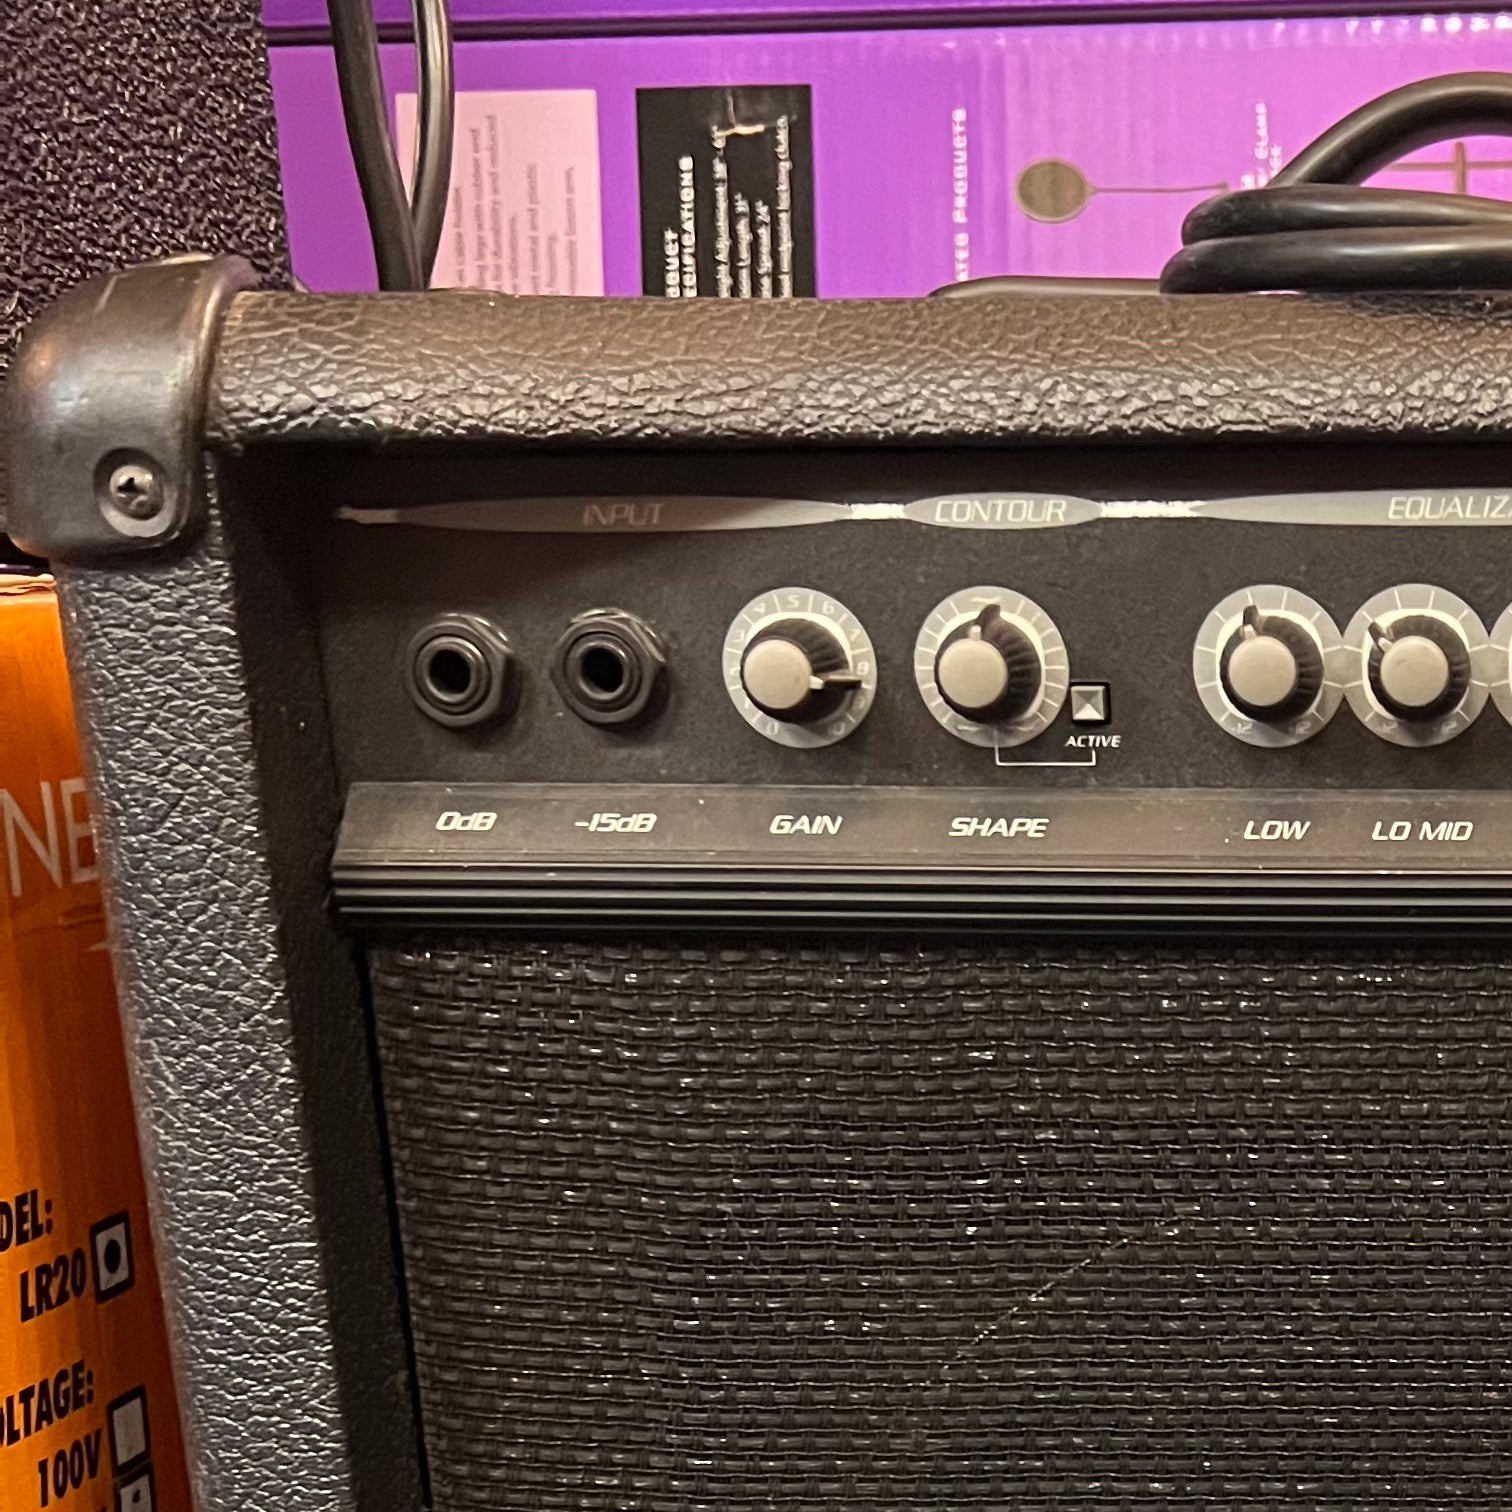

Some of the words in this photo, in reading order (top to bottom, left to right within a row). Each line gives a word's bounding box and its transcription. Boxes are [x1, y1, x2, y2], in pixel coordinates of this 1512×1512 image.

[951, 107, 968, 224] PRODUCTS
[583, 503, 666, 526] INPUT
[934, 499, 1068, 523] CONTOUR
[1065, 734, 1122, 748] ACTIVE
[574, 812, 657, 833] -15dB
[769, 815, 843, 836] GAIN
[948, 816, 1050, 839] SHAPE
[1243, 820, 1311, 841] LOW
[1371, 821, 1414, 841] LO
[1418, 821, 1474, 841] MID
[20, 1247, 87, 1323] LR20
[0, 1359, 94, 1447] LTAGE:
[38, 1426, 104, 1508] 100V
